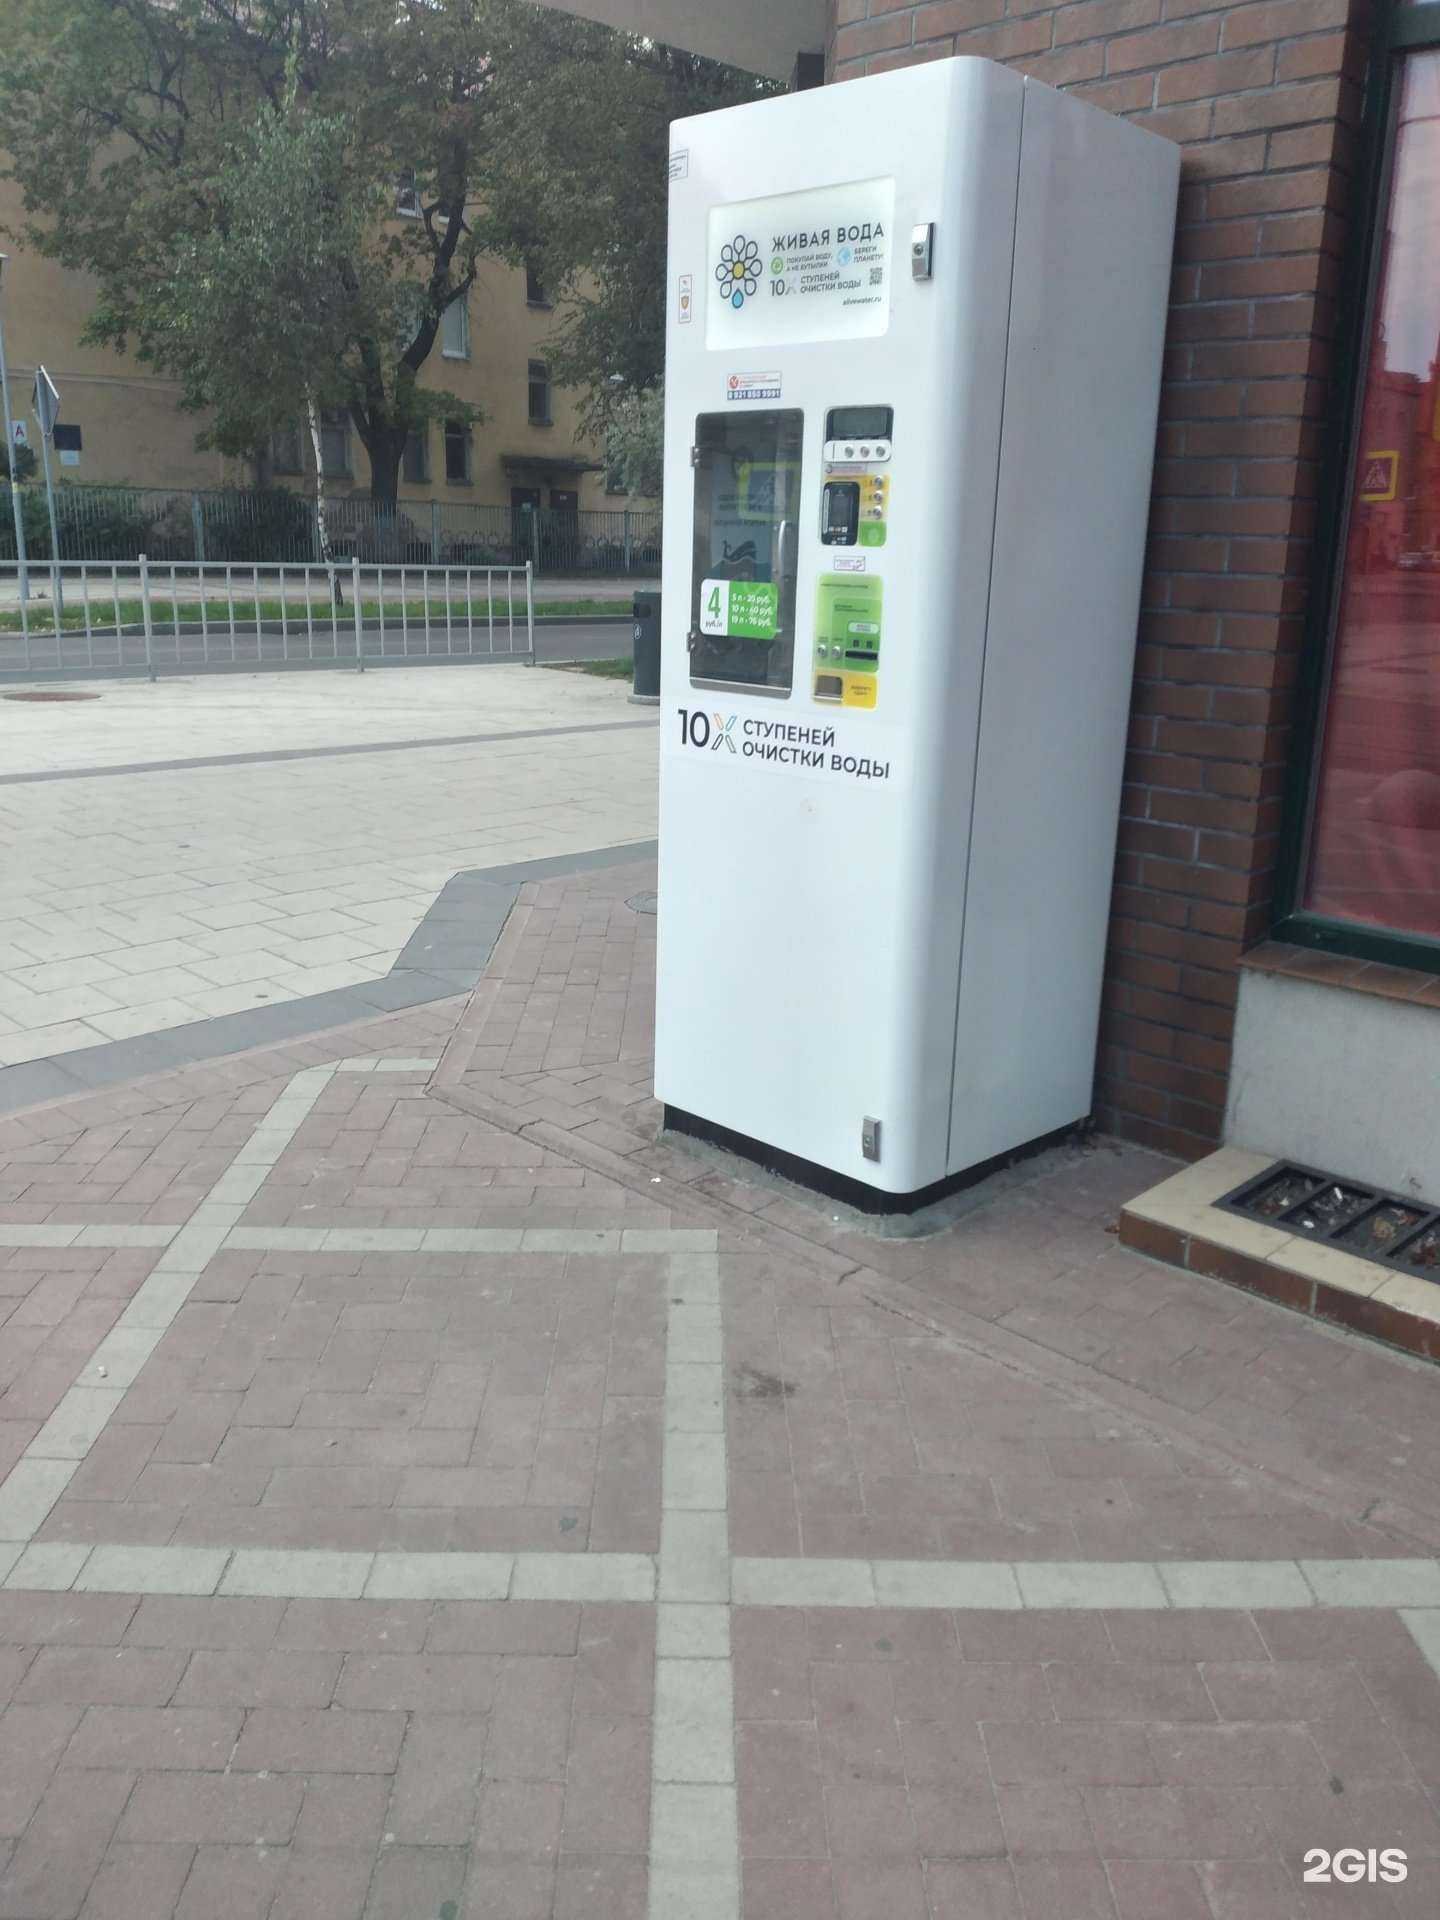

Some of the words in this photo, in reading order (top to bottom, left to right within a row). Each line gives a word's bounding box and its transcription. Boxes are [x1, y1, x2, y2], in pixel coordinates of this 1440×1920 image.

[771, 229, 830, 252] ЖИВАЯ
[837, 222, 884, 243] ВОДА
[800, 270, 840, 284] СТУПЕНЕЙ
[800, 282, 836, 294] ОЧИСТКИ
[837, 280, 861, 289] ВОДЫ
[707, 587, 721, 619] 4
[743, 719, 836, 748] СТУПЕНЕЙ
[742, 742, 824, 769] ОЧИСТКИ
[831, 754, 890, 779] ВОДЫ
